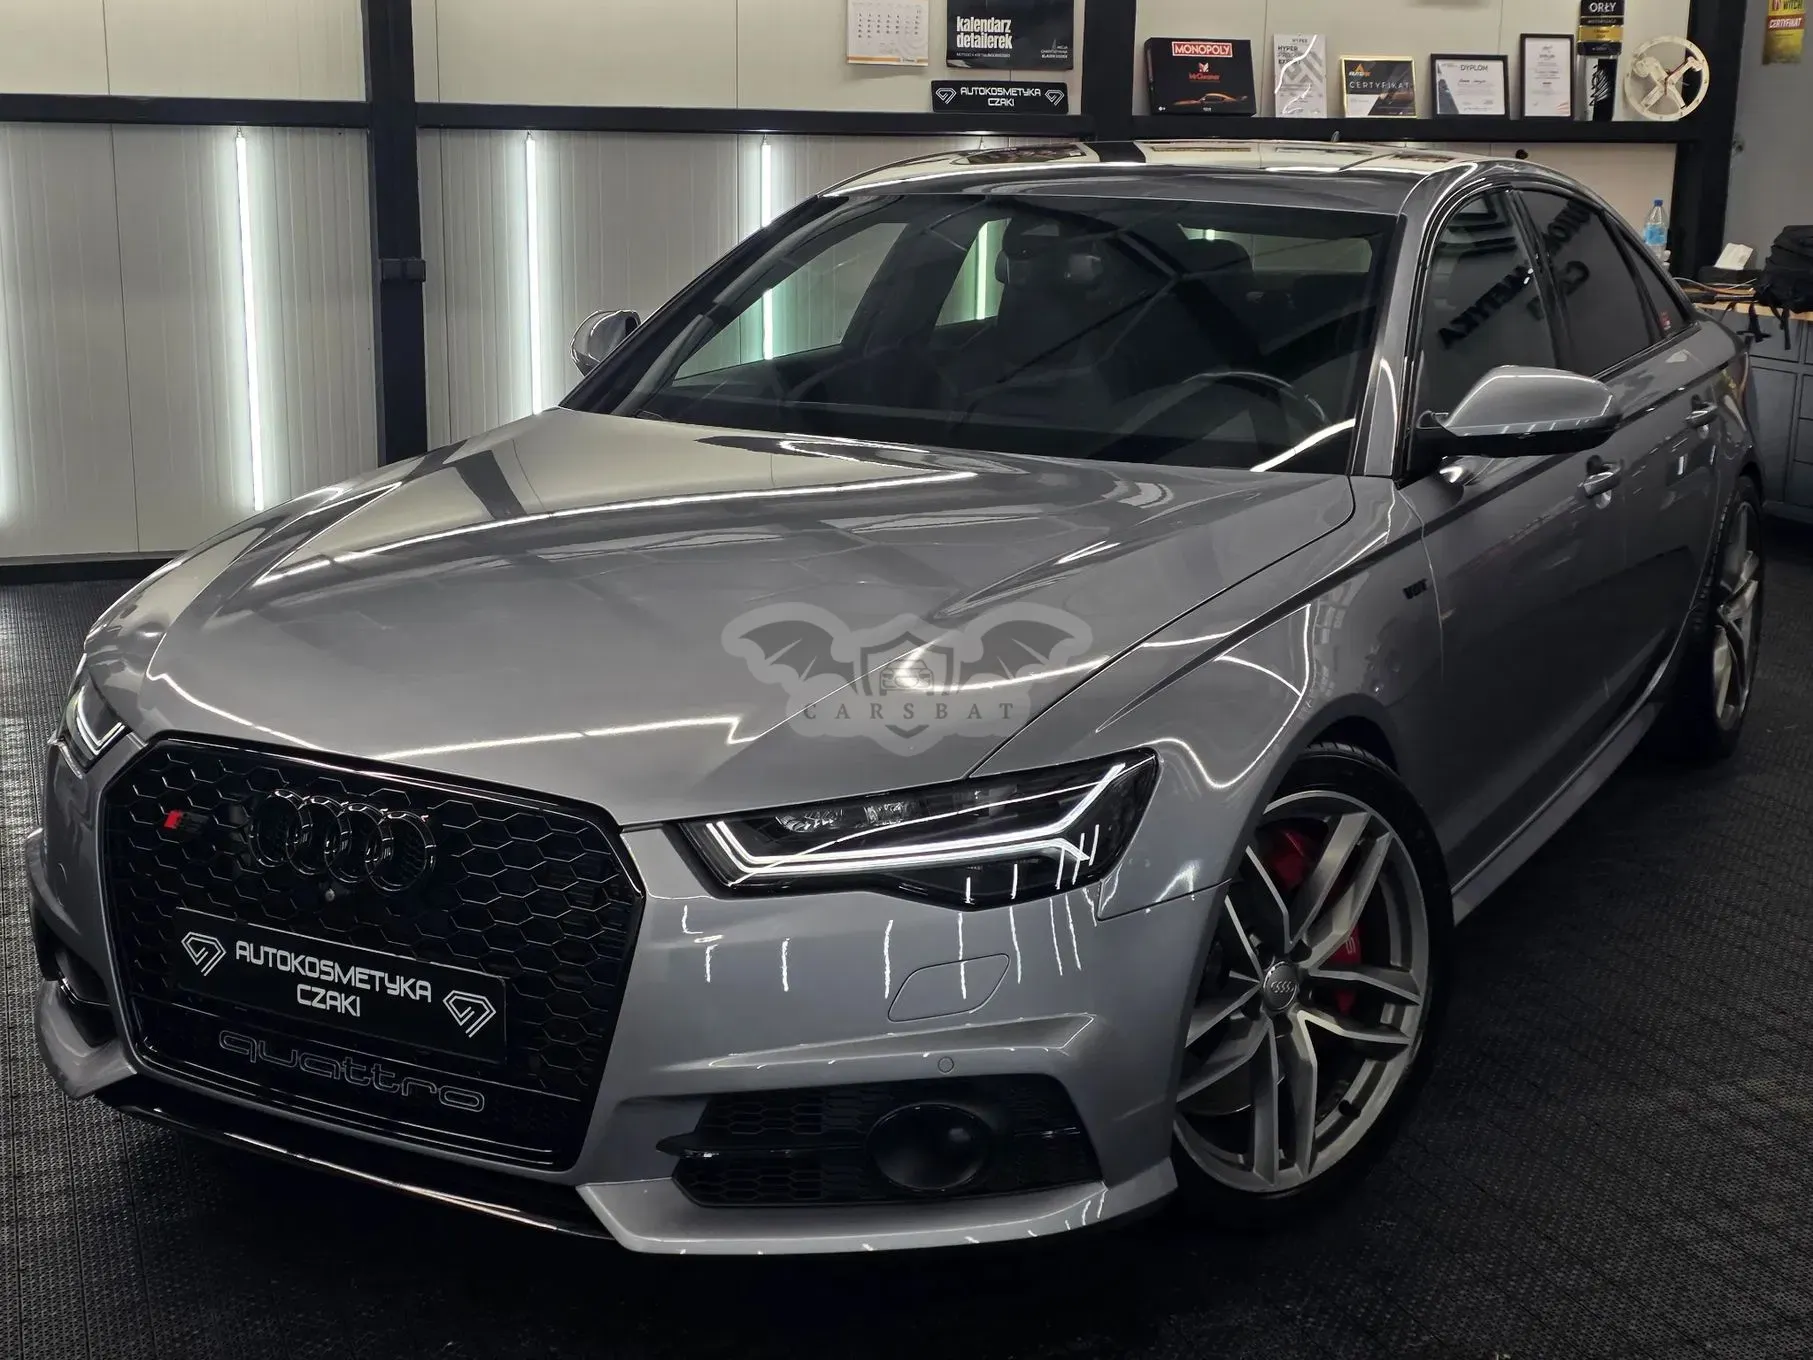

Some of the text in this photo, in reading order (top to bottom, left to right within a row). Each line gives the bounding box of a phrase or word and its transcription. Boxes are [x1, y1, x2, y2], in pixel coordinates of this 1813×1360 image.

[1589, 2, 1617, 12] ORŁY
[956, 16, 1012, 33] kalendarz
[956, 32, 1013, 49] detailerek
[1174, 44, 1230, 55] MONOPOLY
[1460, 64, 1488, 72] DYPLOM
[1349, 81, 1410, 89] CERTYFIKAT
[960, 87, 1041, 96] AUTOKOSMETYKA
[987, 98, 1015, 106] CZAKI
[235, 940, 432, 1003] AUTOKOSMETYKA
[296, 983, 361, 1018] CZAKI
[219, 1030, 486, 1113] quattro
